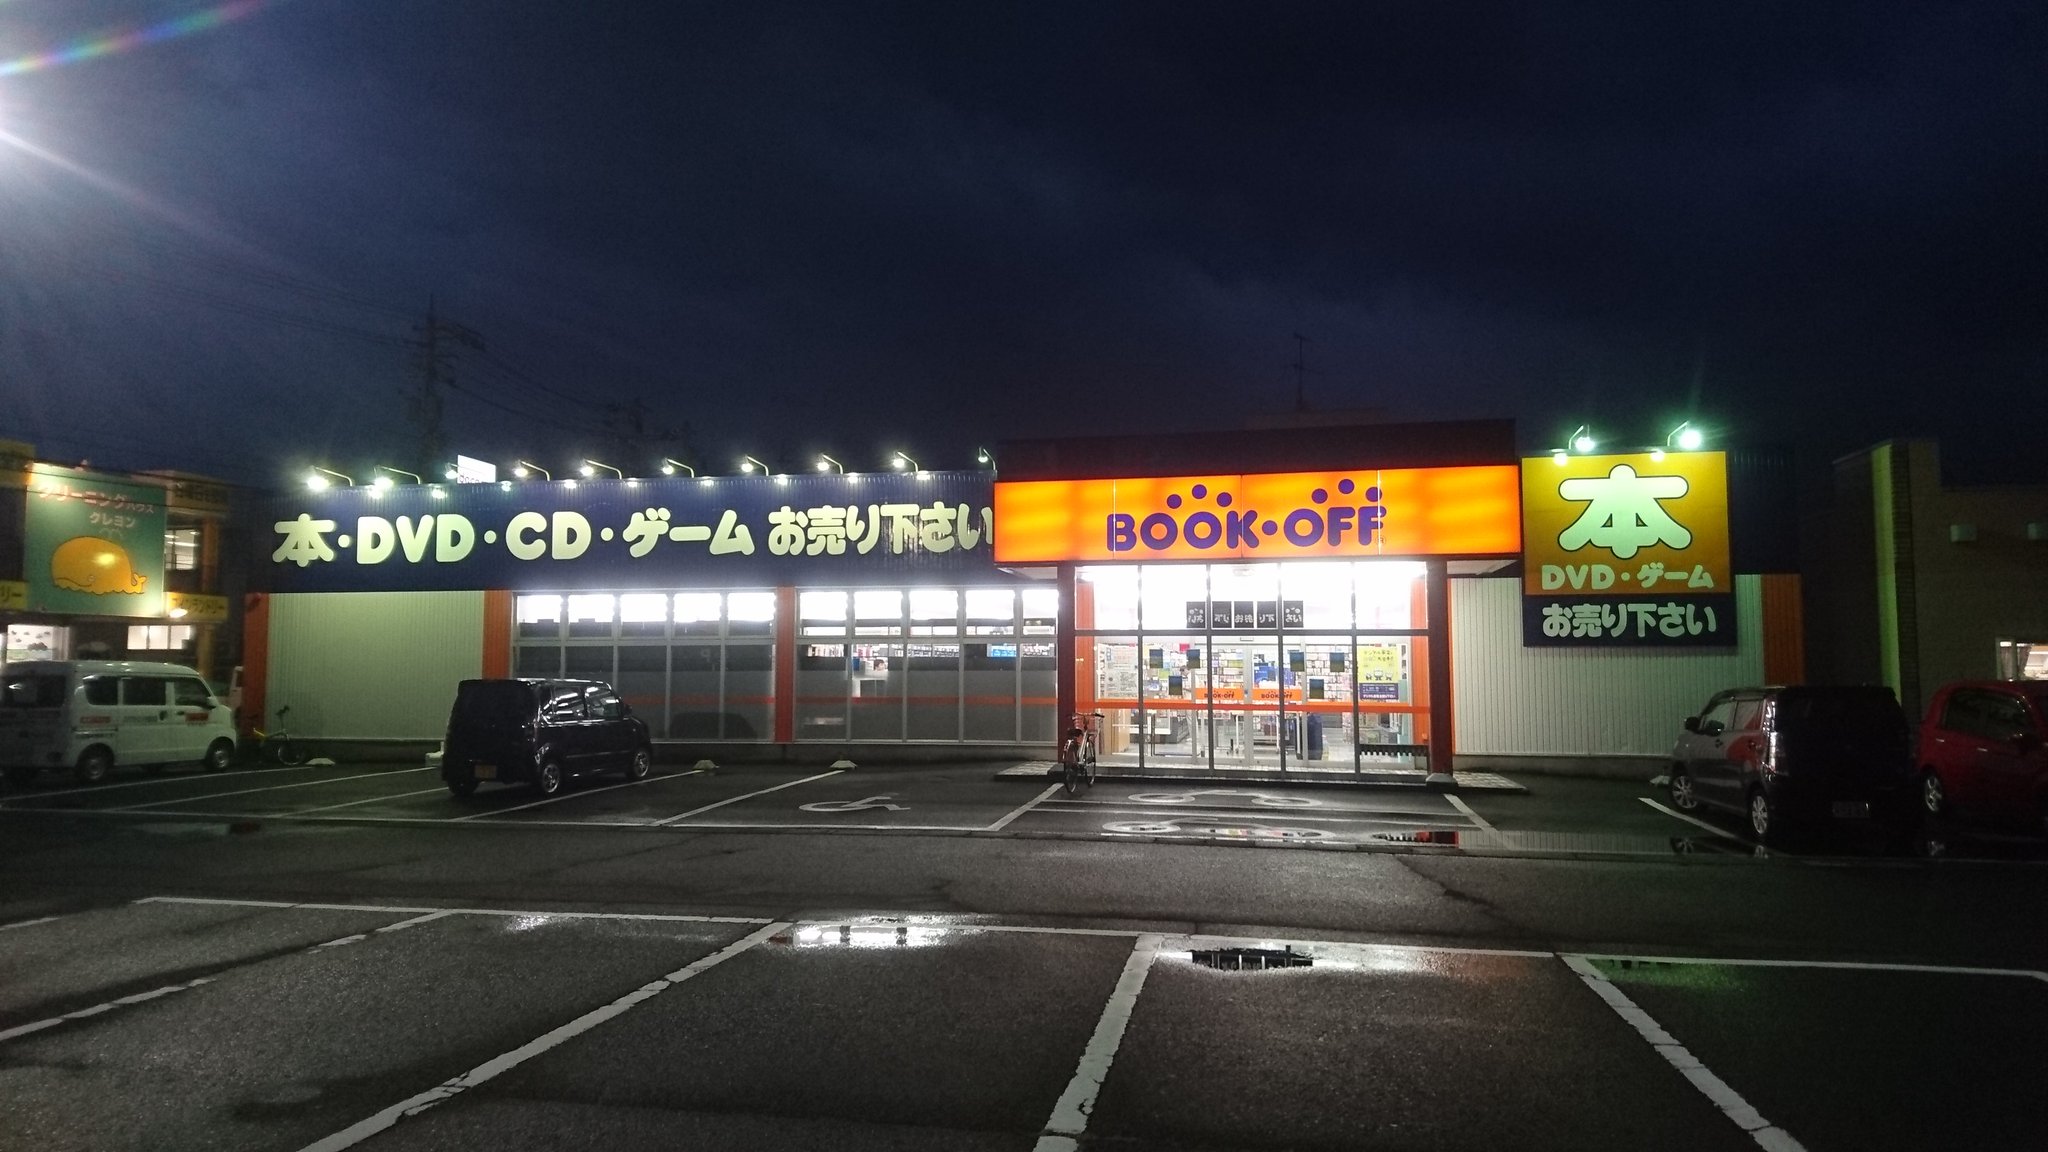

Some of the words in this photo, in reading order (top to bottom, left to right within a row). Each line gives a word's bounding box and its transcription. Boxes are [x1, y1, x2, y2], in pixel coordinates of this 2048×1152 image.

[768, 501, 993, 556] お売り下さい
[1558, 464, 1692, 560] 本
[1542, 602, 1716, 638] お売り下さい
